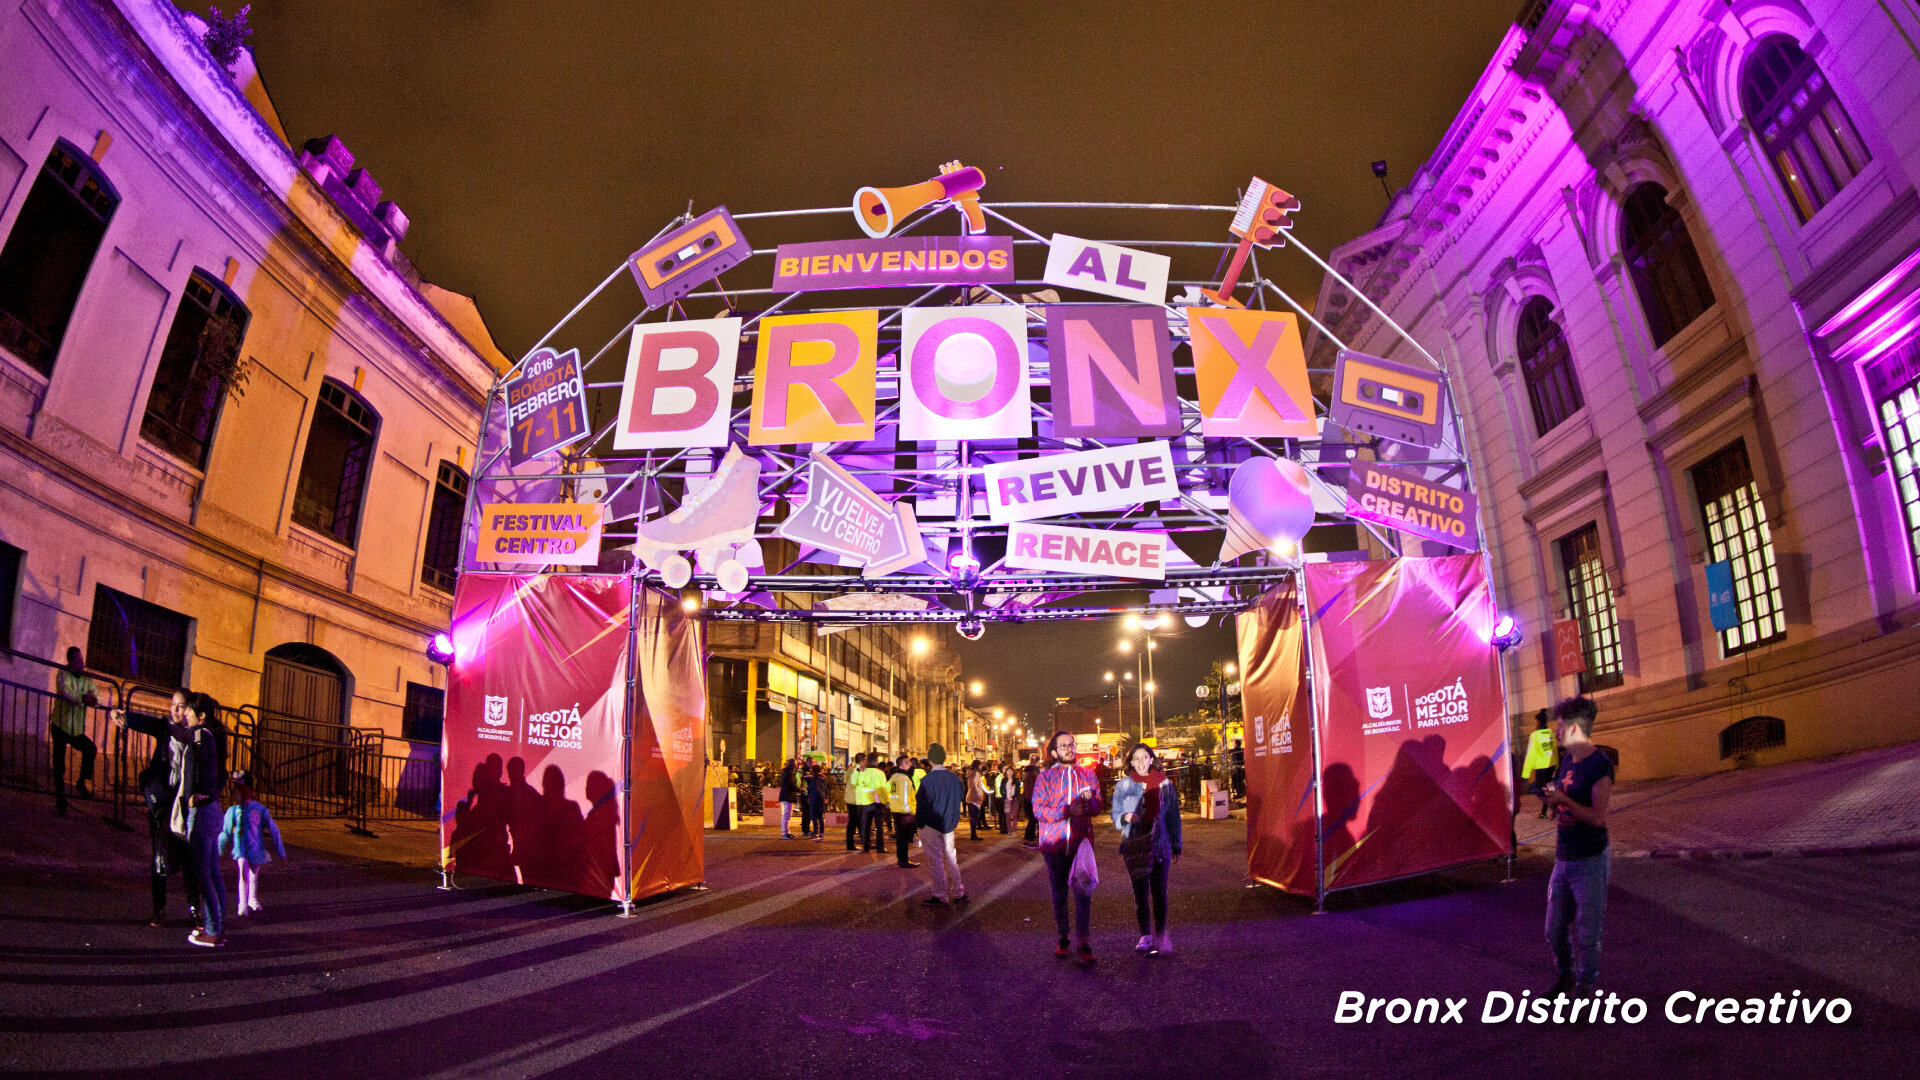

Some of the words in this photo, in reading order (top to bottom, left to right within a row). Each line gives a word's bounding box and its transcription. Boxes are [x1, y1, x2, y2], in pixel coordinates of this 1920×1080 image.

[778, 249, 1009, 278] BIENVENIDOS
[1066, 245, 1147, 291] AL
[510, 360, 576, 404] BOGOTÁ
[527, 357, 553, 379] 2018
[627, 316, 1309, 434] BRONX
[508, 378, 580, 428] FEBRERO
[517, 401, 577, 454] 7-11
[997, 455, 1166, 506] REVIVE
[1366, 469, 1464, 514] DISTRITO
[491, 514, 587, 531] FESTIVAL
[819, 478, 879, 534] VUELVE
[876, 522, 885, 538] A
[1361, 492, 1466, 538] CREATIVO
[494, 536, 577, 555] CENTRO
[812, 504, 836, 532] TU
[834, 519, 881, 555] CENTRO
[1014, 531, 1161, 569] RENACE
[1415, 676, 1467, 706] BOGOTÁ
[1416, 700, 1469, 720] MEJOR
[528, 722, 583, 740] MEJOR
[529, 702, 583, 726] BOGOTÁ
[1417, 718, 1440, 728] PARA
[1441, 713, 1469, 725] TODOS
[528, 737, 550, 746] PARA
[552, 739, 582, 749] TODOS
